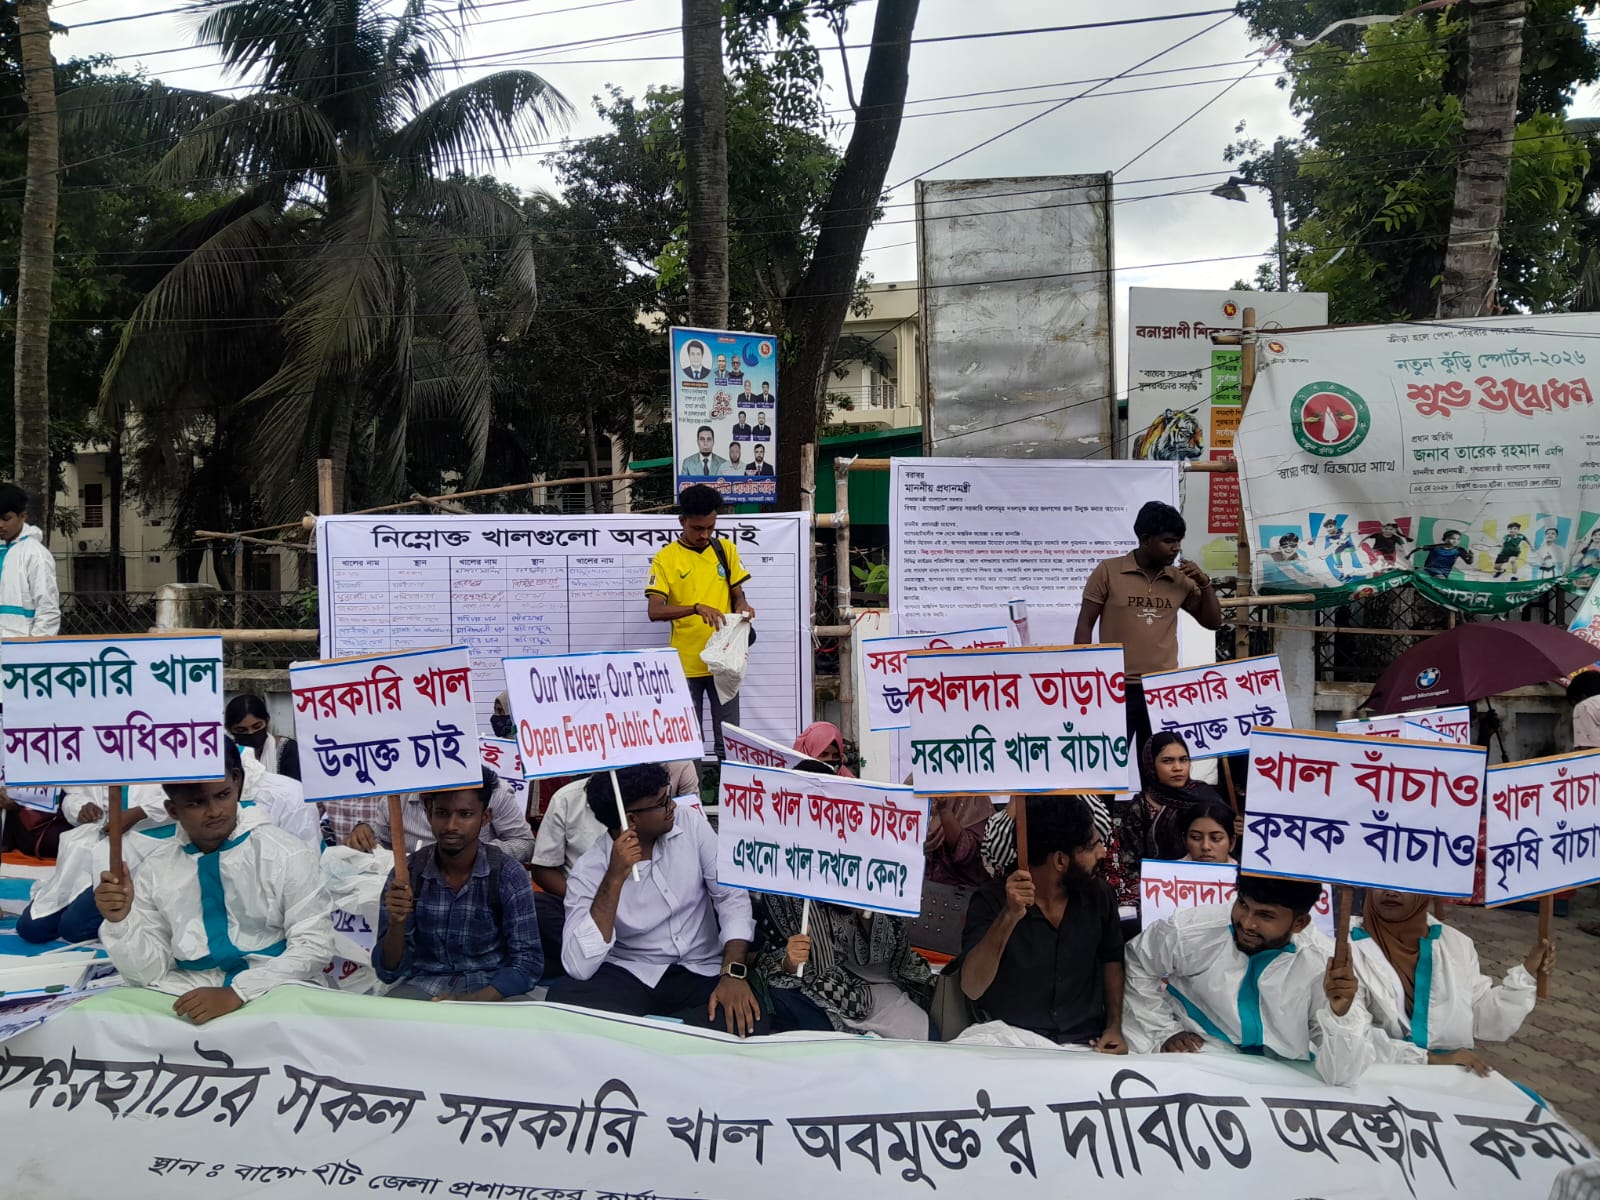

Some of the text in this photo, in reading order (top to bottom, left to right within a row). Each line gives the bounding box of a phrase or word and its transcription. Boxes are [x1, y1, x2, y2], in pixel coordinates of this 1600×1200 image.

[1136, 321, 1190, 339] বন্যপ্রাণী
[1394, 348, 1586, 376] নতুন কুঁড়ি স্পোর্টস-২০২৬
[1406, 380, 1471, 417] শুভ
[1474, 376, 1594, 416] উদ্বোধন
[1411, 432, 1453, 443] প্রধান অতিথি
[1412, 448, 1450, 463] জনাব
[1454, 445, 1496, 459] তারেক
[1500, 443, 1540, 458] রহমান
[904, 481, 971, 493] মাননীয় প্রধানমন্ত্রী
[1370, 460, 1396, 473] সাথে
[370, 525, 471, 550] নিম্নোক্ত
[482, 527, 600, 549] খালগুলো
[609, 527, 684, 548] অবমু
[1127, 596, 1173, 609] PRADA
[1, 646, 224, 700] সরকারি খাল
[292, 665, 472, 720] সরকারি খাল
[530, 660, 675, 705] Our Water, Our Right
[908, 670, 1022, 713] দখলদার
[1029, 667, 1126, 715] তাড়াও
[1143, 668, 1281, 710] সরকারি খাল
[3, 710, 223, 765] সবার অধিকার
[313, 734, 400, 786] উন্মুক্ত
[408, 720, 467, 769] চাই
[520, 719, 563, 766] Open
[562, 715, 606, 761] Every
[605, 711, 653, 749] Public
[911, 721, 1128, 774] সরকারি খাল বাঁচাও
[1254, 750, 1479, 808] খাল বাঁচাও
[1493, 767, 1600, 822] খাল বাঁচা
[723, 774, 922, 844] সবাই খাল অবমুক্ত চাইলে
[1246, 809, 1476, 867] কৃষক বাঁচাও
[1488, 820, 1600, 892] কৃষি বাঁচা
[733, 837, 908, 897] এখনো খাল দখলে কেন?
[278, 1064, 427, 1134] সকল
[437, 1078, 648, 1158] সরকারি
[666, 1107, 773, 1165] খাল
[1046, 1068, 1252, 1179] দাবিতে
[1261, 1096, 1458, 1200] অবস্থান
[148, 1156, 205, 1176] স্থান
[368, 1174, 443, 1195] জেলা
[448, 1180, 588, 1200] প্রশাসকের
